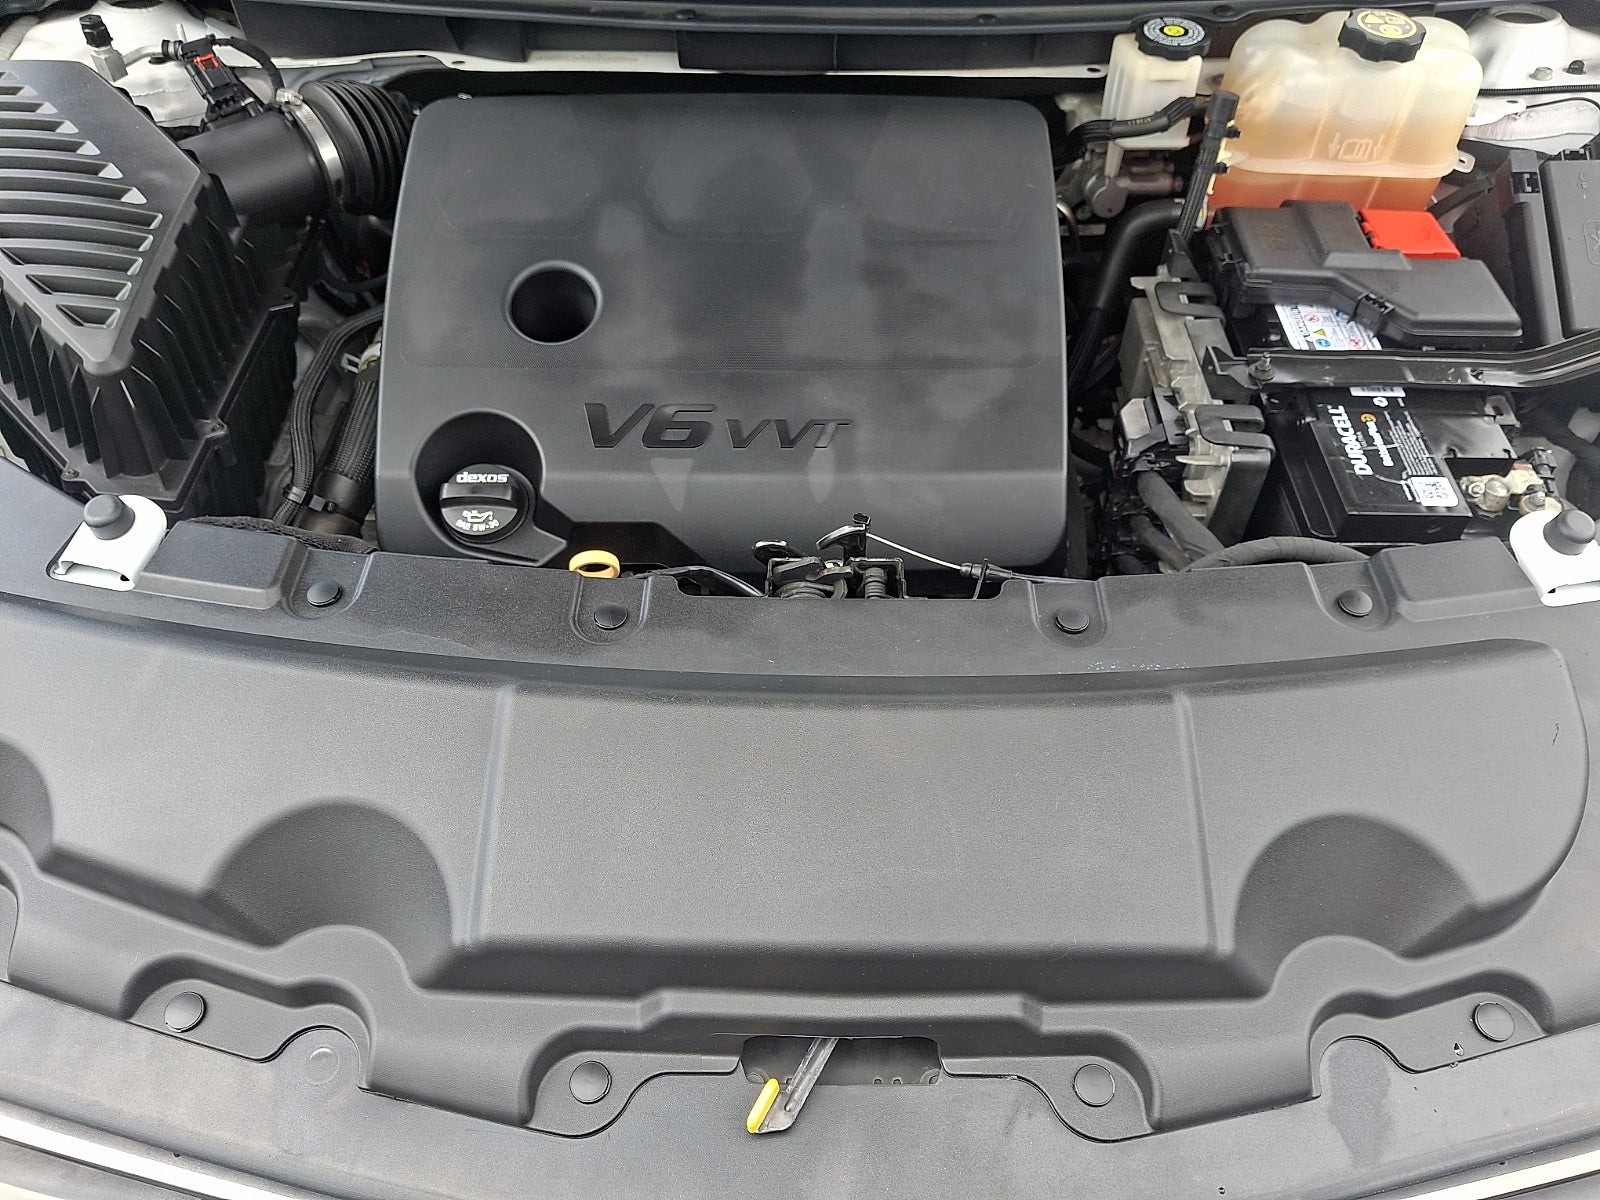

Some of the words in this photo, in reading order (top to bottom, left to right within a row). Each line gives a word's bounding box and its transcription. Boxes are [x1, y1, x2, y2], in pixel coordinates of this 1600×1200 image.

[584, 403, 715, 448] V6
[726, 418, 852, 448] VVT
[1328, 405, 1373, 475] DURACELL
[456, 472, 509, 483] dexos
